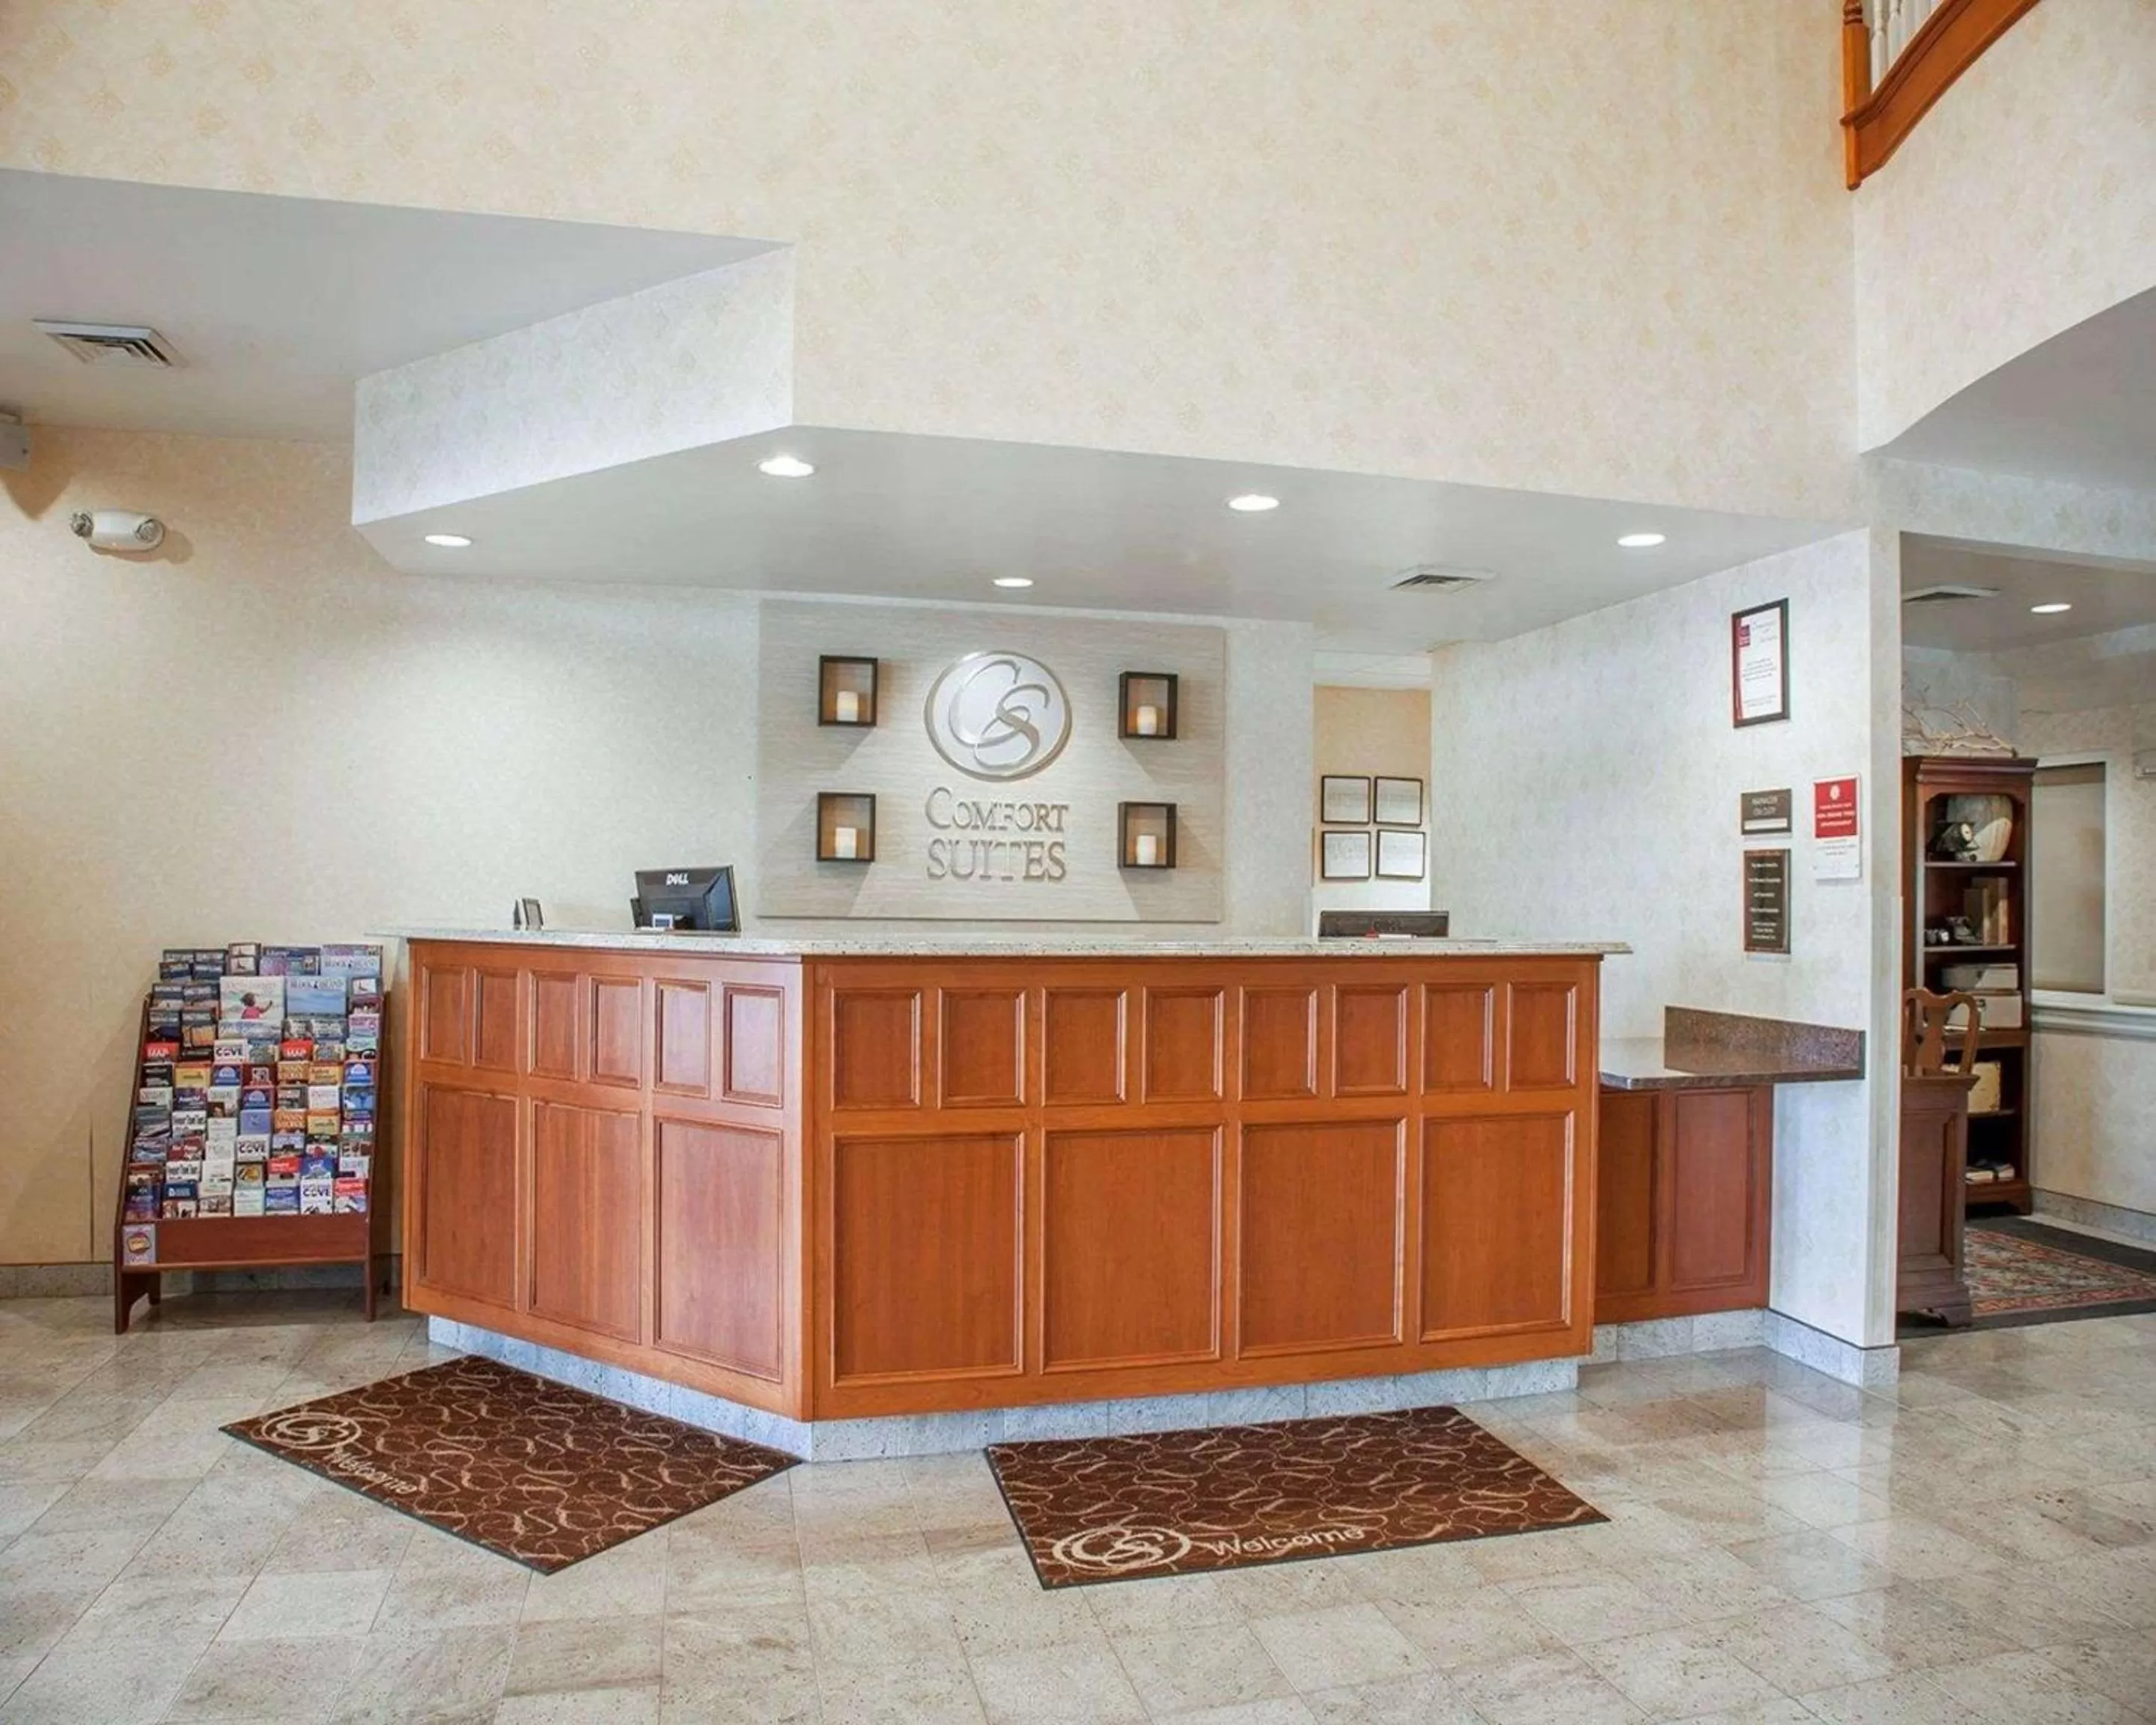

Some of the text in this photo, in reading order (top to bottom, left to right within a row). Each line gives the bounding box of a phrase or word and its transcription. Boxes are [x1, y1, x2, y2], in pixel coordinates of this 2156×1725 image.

[927, 838, 1068, 882] SUITES
[666, 872, 689, 886] DELL
[1206, 1526, 1366, 1557] Welcome
